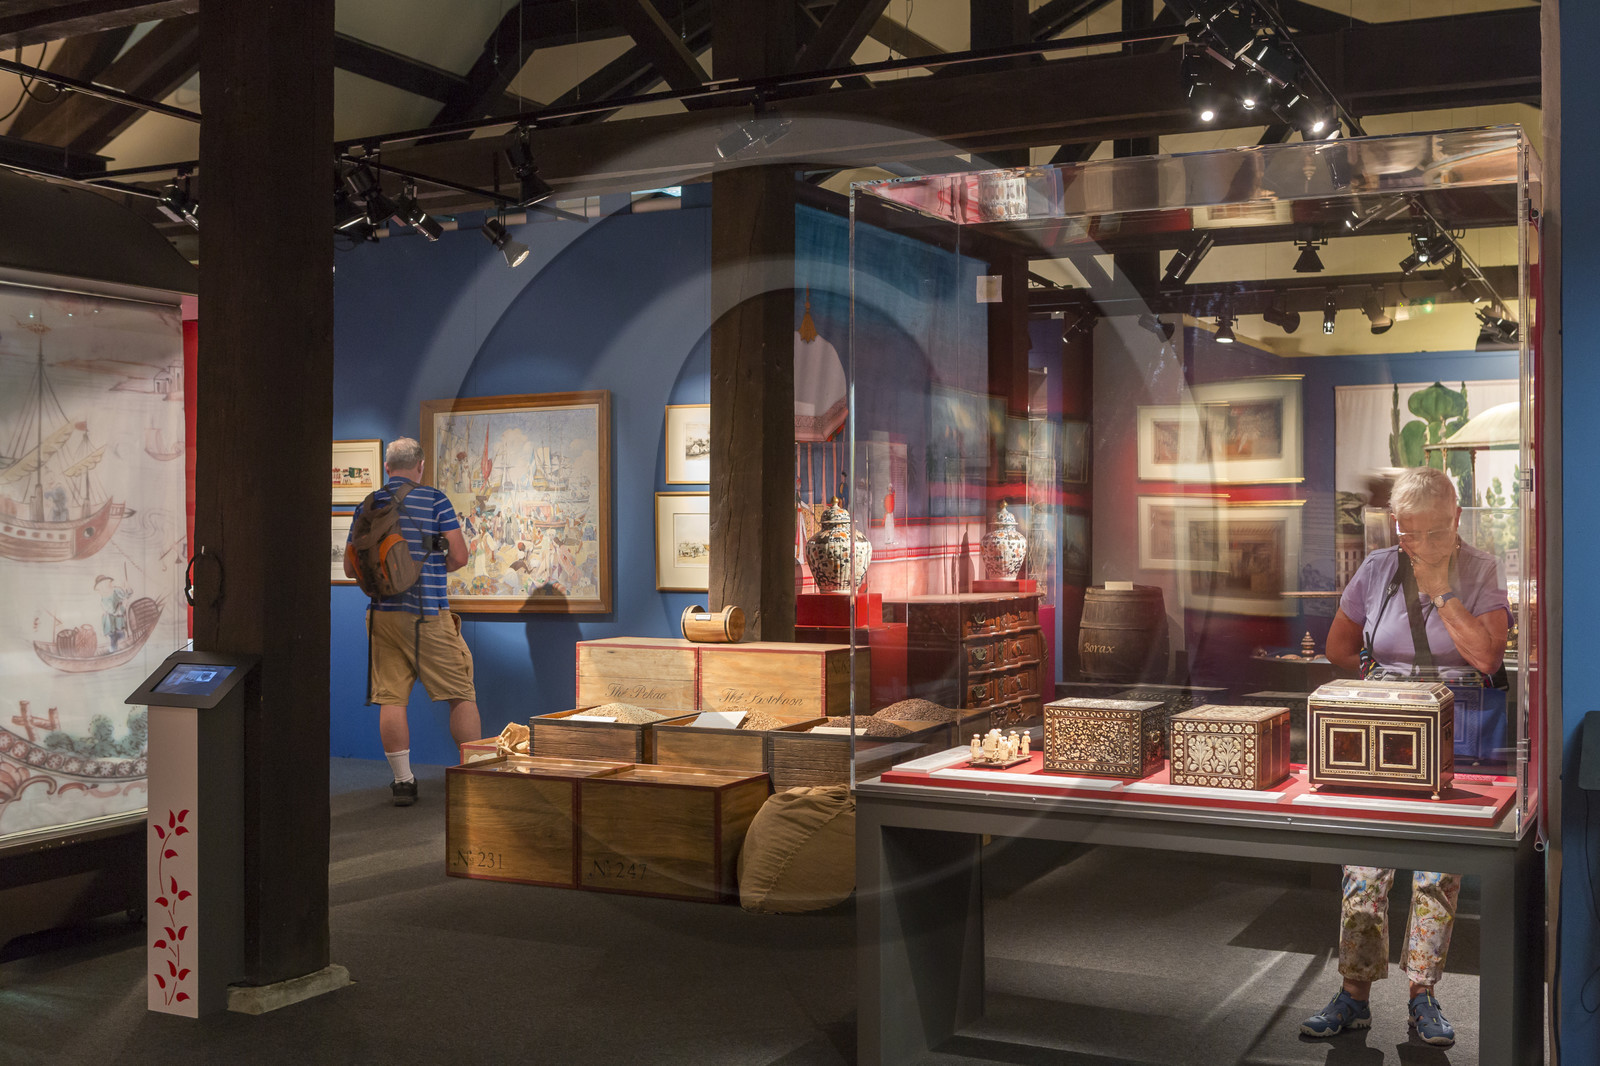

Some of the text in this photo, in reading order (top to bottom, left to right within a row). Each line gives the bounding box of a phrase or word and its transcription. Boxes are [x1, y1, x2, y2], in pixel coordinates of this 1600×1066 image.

[1084, 642, 1116, 654] Borax
[605, 682, 629, 697] Thé
[719, 688, 744, 703] Thé
[478, 851, 504, 869] 231
[615, 862, 648, 880] 247
